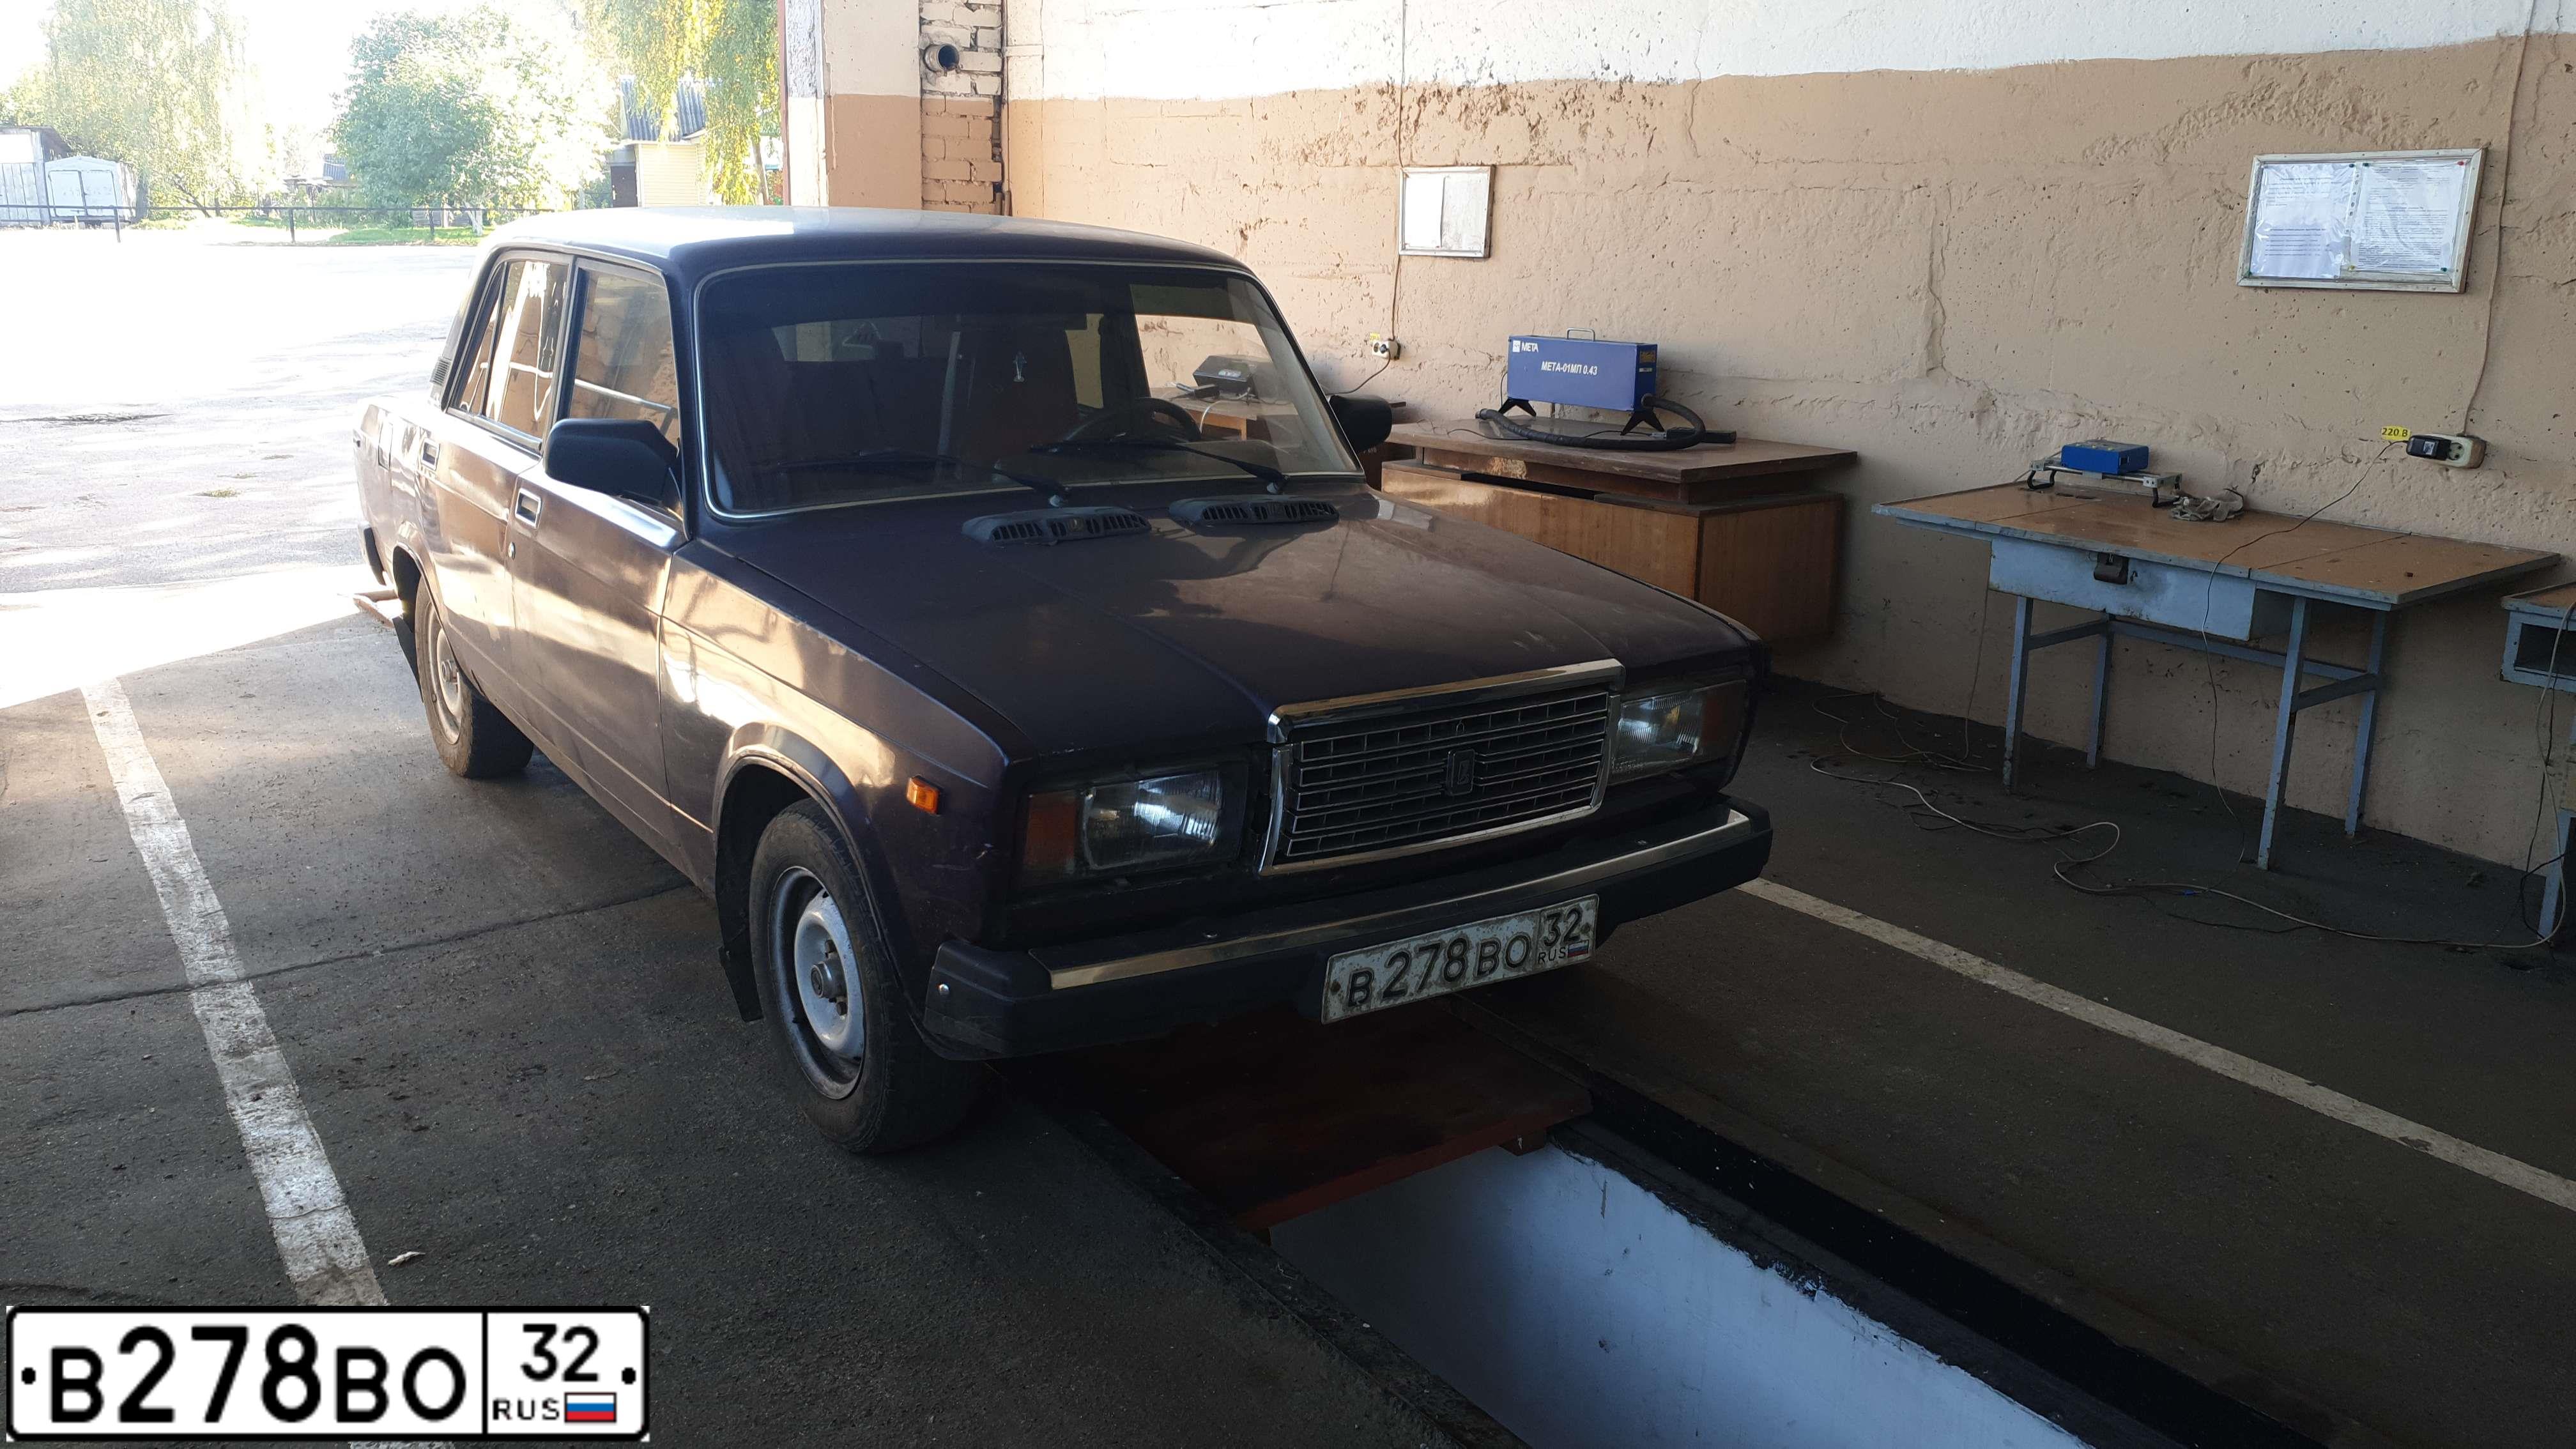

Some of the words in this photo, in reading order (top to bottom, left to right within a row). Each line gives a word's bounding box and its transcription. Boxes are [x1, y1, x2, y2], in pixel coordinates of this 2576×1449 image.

[1583, 365, 1598, 376] 0.43
[2382, 427, 2400, 436] 220
[1544, 907, 1583, 947] 32
[1537, 947, 1567, 965] RUS
